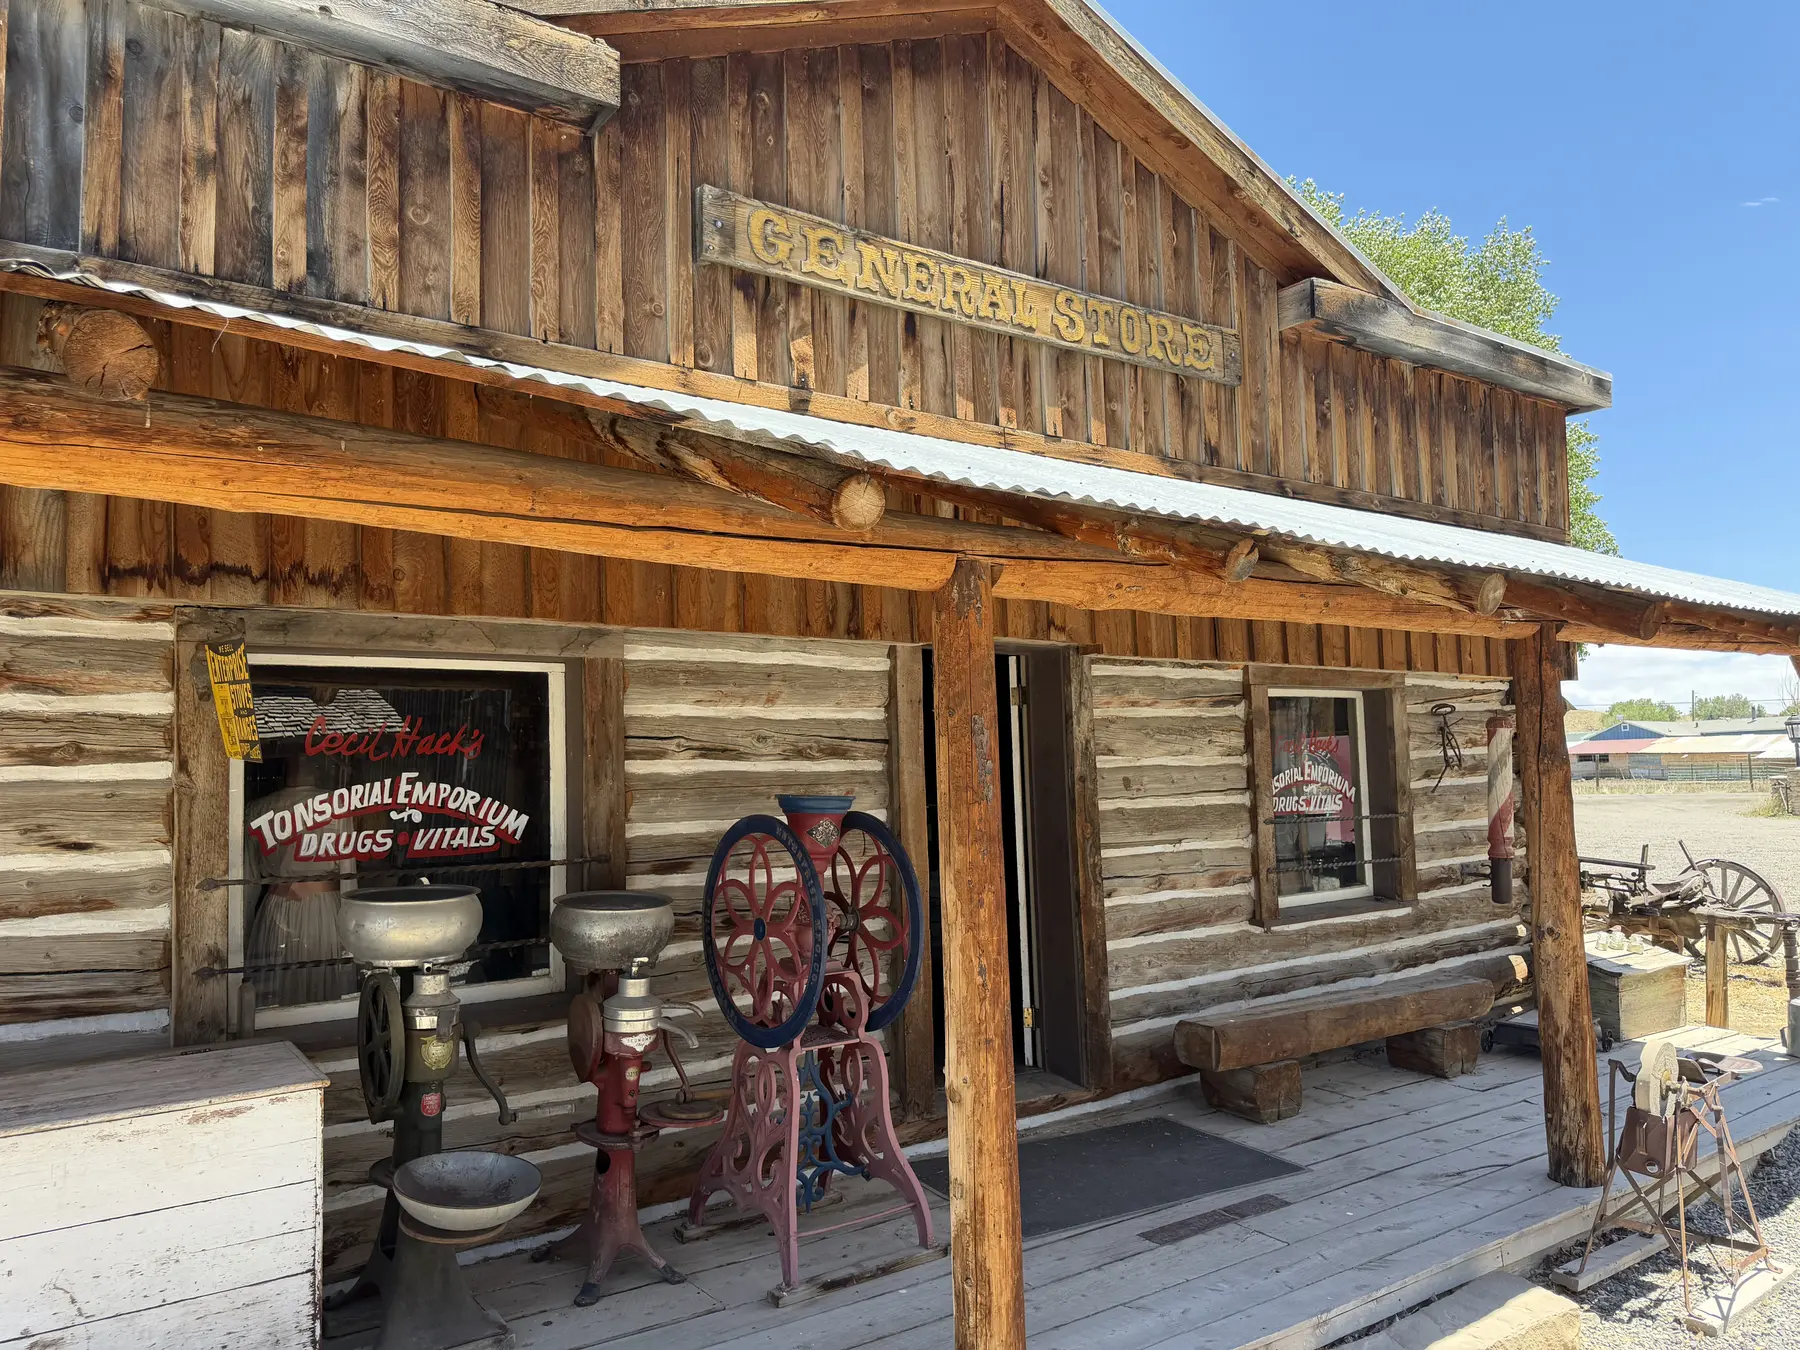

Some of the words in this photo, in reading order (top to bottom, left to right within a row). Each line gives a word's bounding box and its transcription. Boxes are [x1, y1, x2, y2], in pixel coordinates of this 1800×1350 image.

[747, 208, 1039, 330] GENERAL
[1053, 290, 1217, 371] STORE
[210, 643, 249, 682] ENTERPRISE
[224, 643, 234, 653] SELL
[230, 684, 253, 709] STOVES
[304, 715, 388, 761] Cecil
[390, 714, 486, 760] Hack's
[1304, 761, 1357, 803] EMPORIUM
[250, 777, 393, 850] TONSORIAL
[396, 771, 530, 844] EMPORIUM
[1309, 793, 1343, 812] VITALS
[298, 828, 395, 859] DRUGS
[412, 825, 498, 853] VITALS
